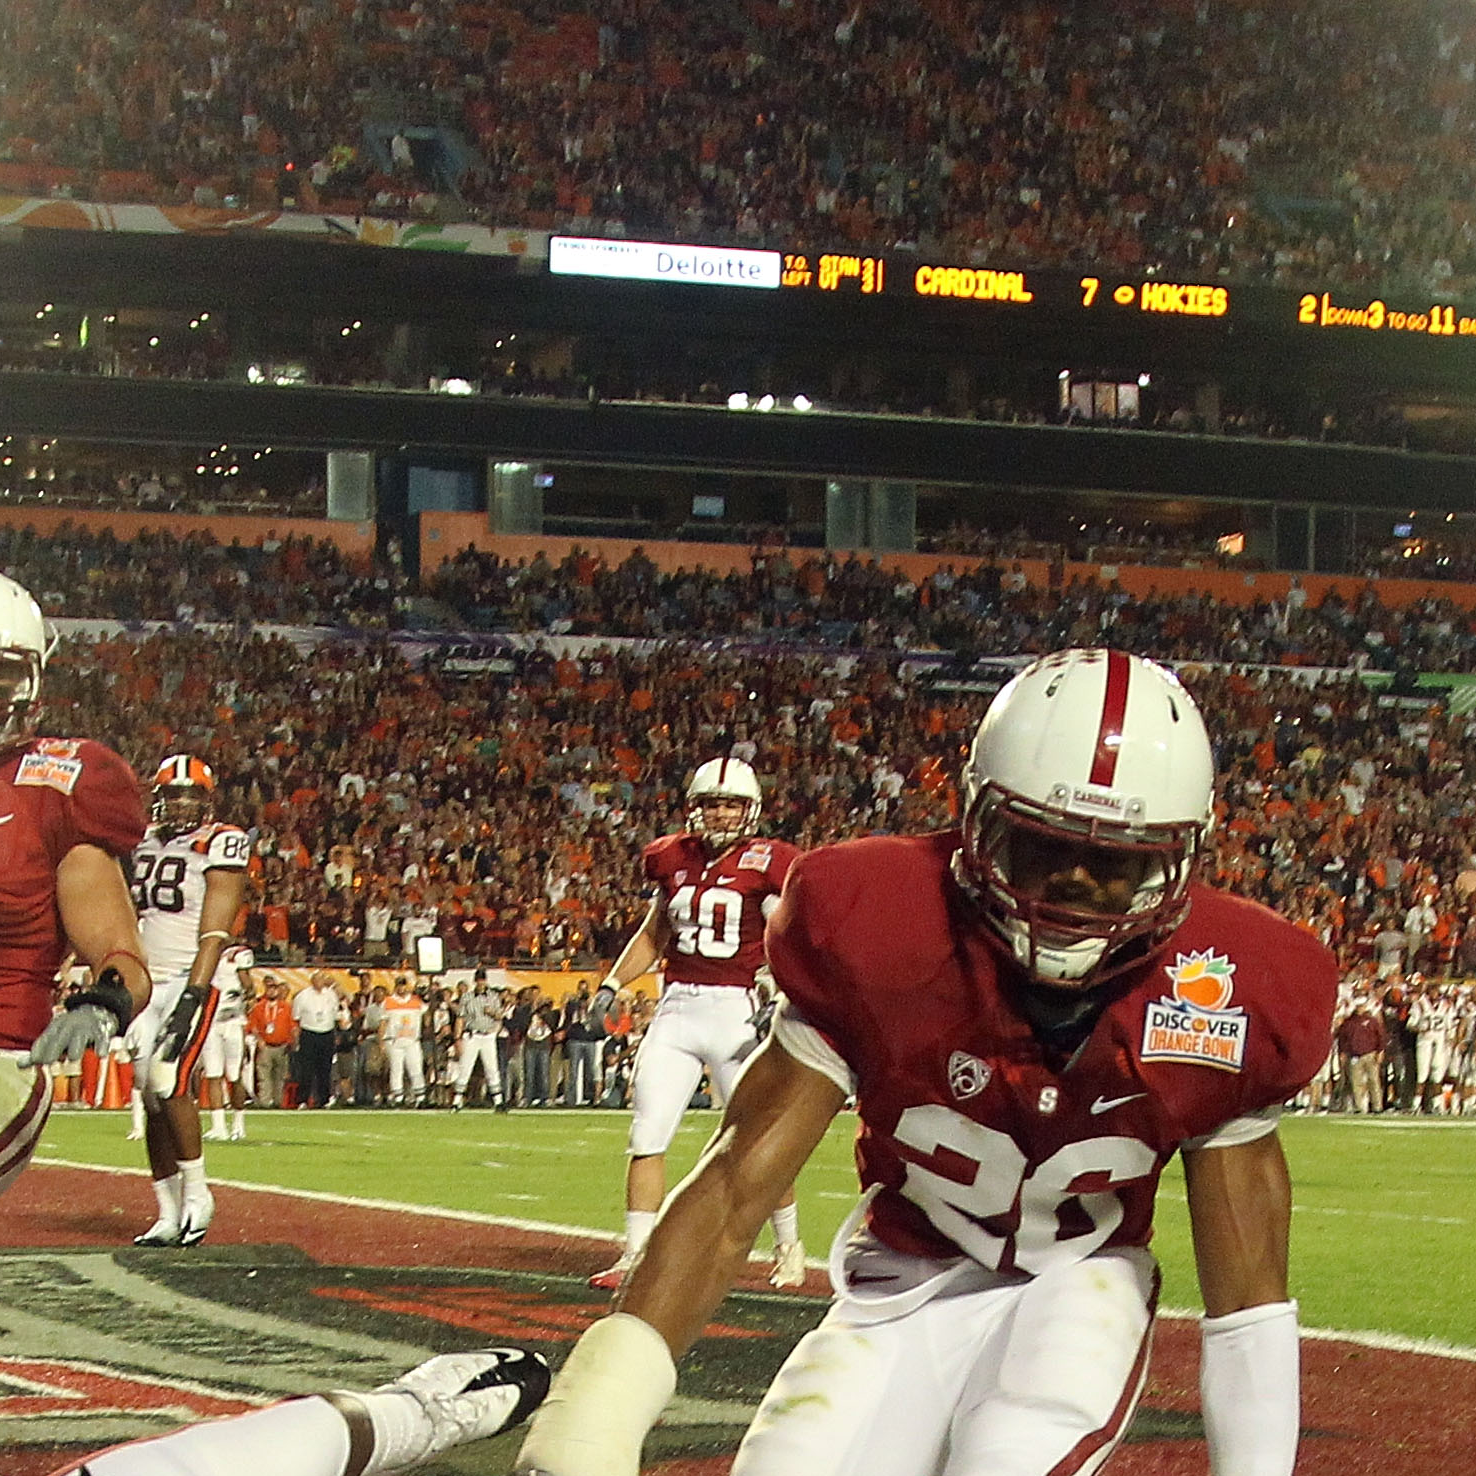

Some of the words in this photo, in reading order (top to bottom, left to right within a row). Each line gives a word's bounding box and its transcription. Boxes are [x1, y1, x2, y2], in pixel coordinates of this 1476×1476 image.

[656, 252, 762, 280] Deloitte
[915, 265, 1033, 303] CARDINAL
[1080, 277, 1099, 307] 7
[1140, 281, 1228, 317] HOKIES
[1298, 294, 1318, 324] 2
[1368, 299, 1387, 330] 3
[1427, 304, 1456, 336] 11
[667, 884, 743, 959] 40
[1152, 1011, 1240, 1039] DISCOVER
[1148, 1028, 1202, 1053] ORANGE
[1202, 1037, 1238, 1063] BOWL
[893, 1103, 1159, 1278] 26
